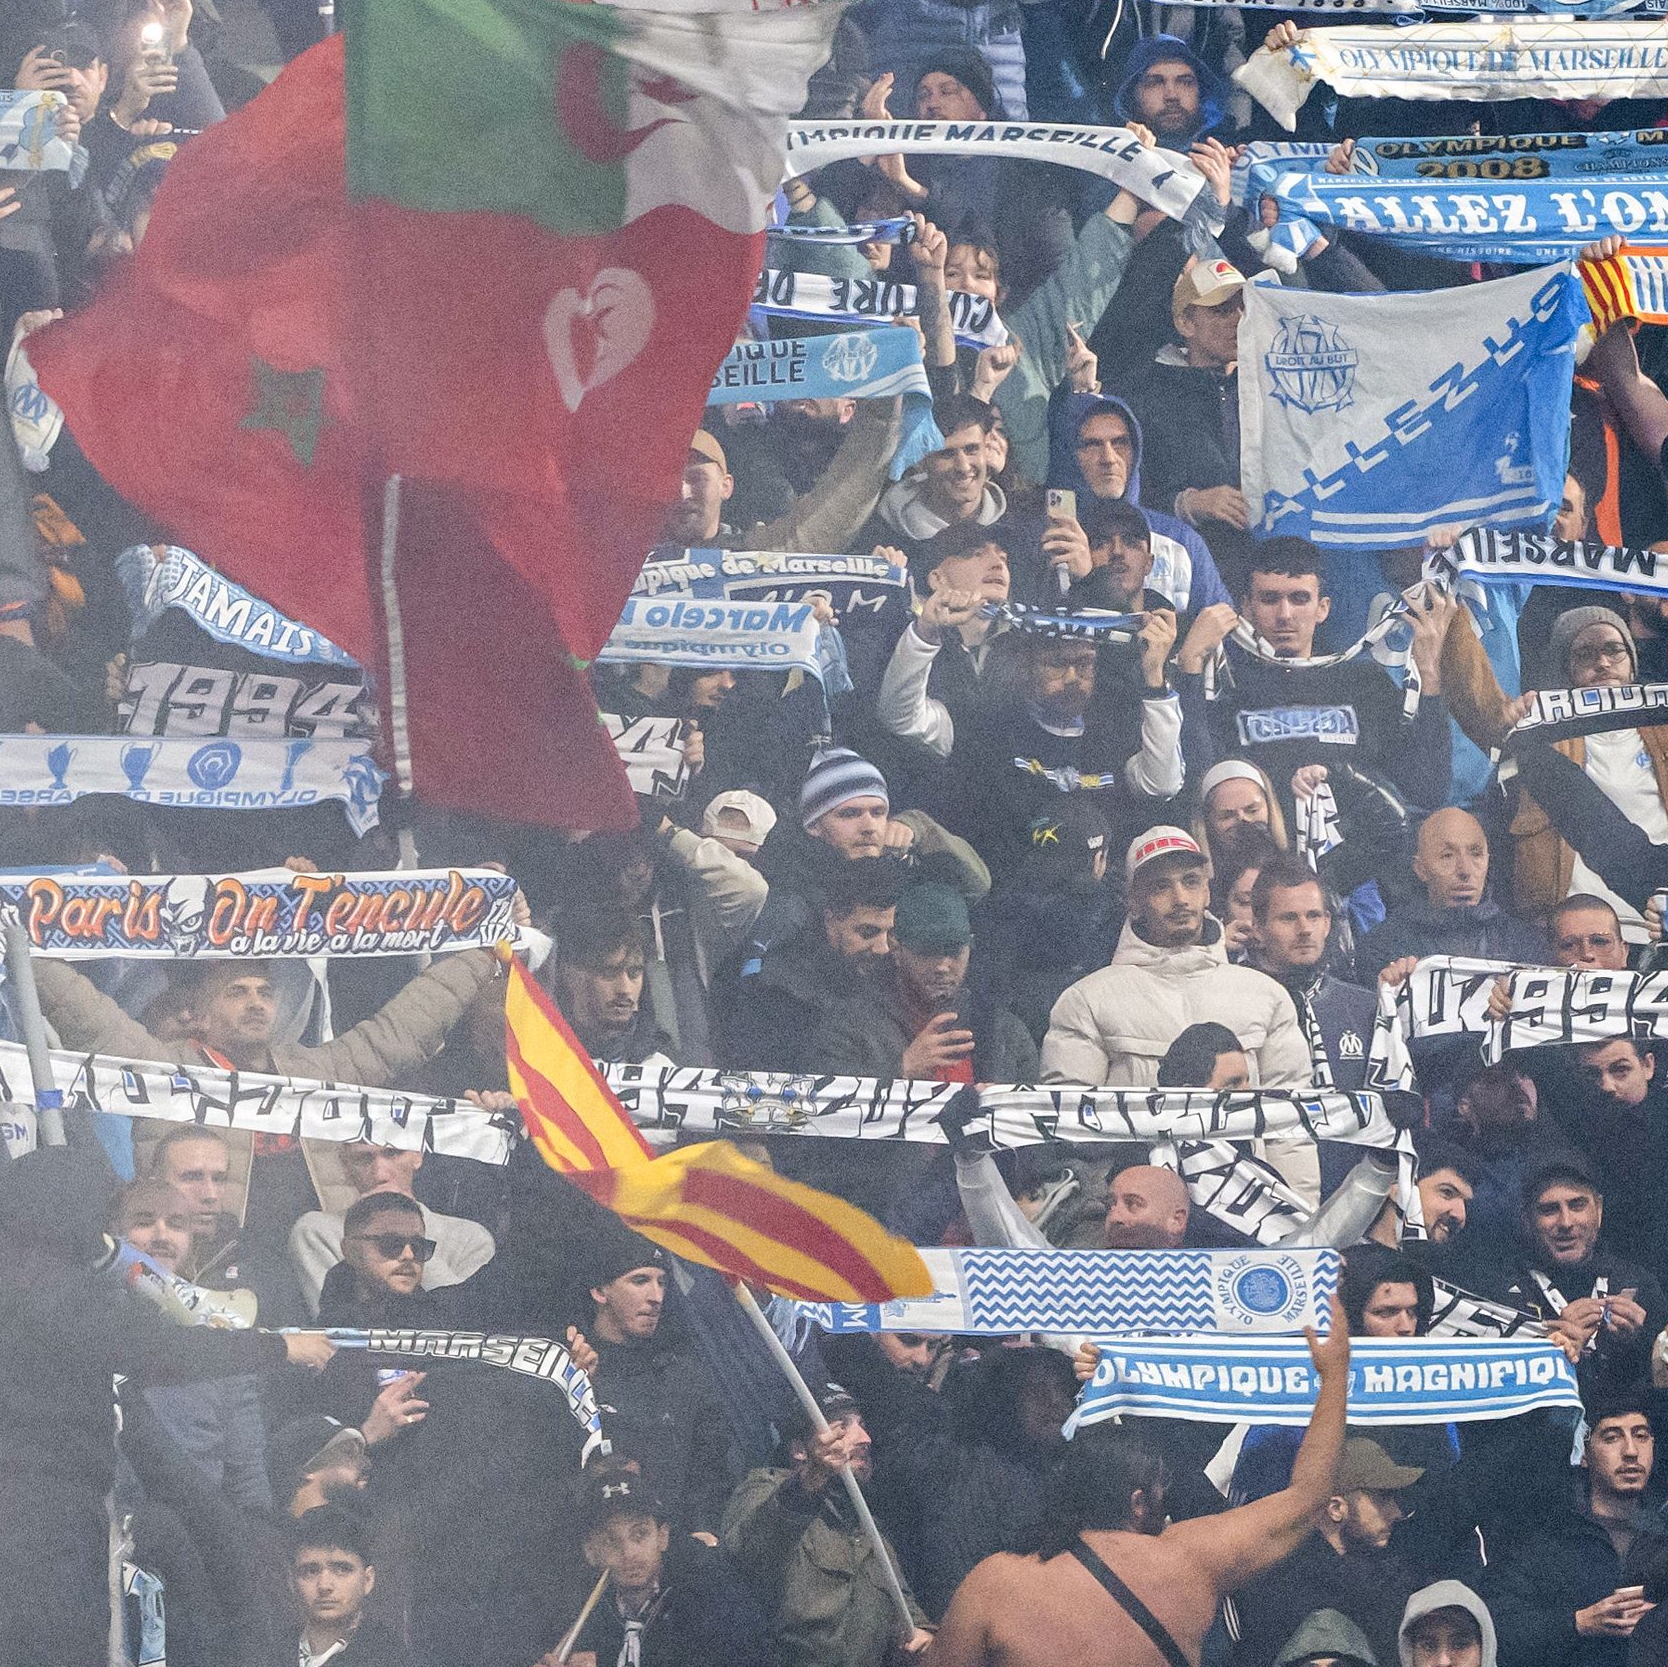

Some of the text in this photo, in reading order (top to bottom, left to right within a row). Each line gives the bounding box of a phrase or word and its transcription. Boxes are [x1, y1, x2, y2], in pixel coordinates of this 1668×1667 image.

[1340, 43, 1482, 75] OLYMPIQUE
[1531, 43, 1668, 73] MARSEILLE
[1374, 134, 1587, 159] OLYMPIQUE
[1416, 155, 1549, 179] 2008
[1335, 192, 1536, 232] ALLEZ
[1264, 360, 1478, 531] ALLEZ
[168, 558, 315, 659] JAMAIS
[126, 662, 361, 737] 1994
[28, 872, 488, 945] Paris On T'encule
[252, 928, 278, 954] la
[282, 928, 324, 953] vie
[352, 926, 376, 952] la
[379, 923, 445, 952] mort
[1218, 1252, 1312, 1328] OLYMPIQUE MARSEILLE
[1092, 1359, 1311, 1395] OLYMPIQUE
